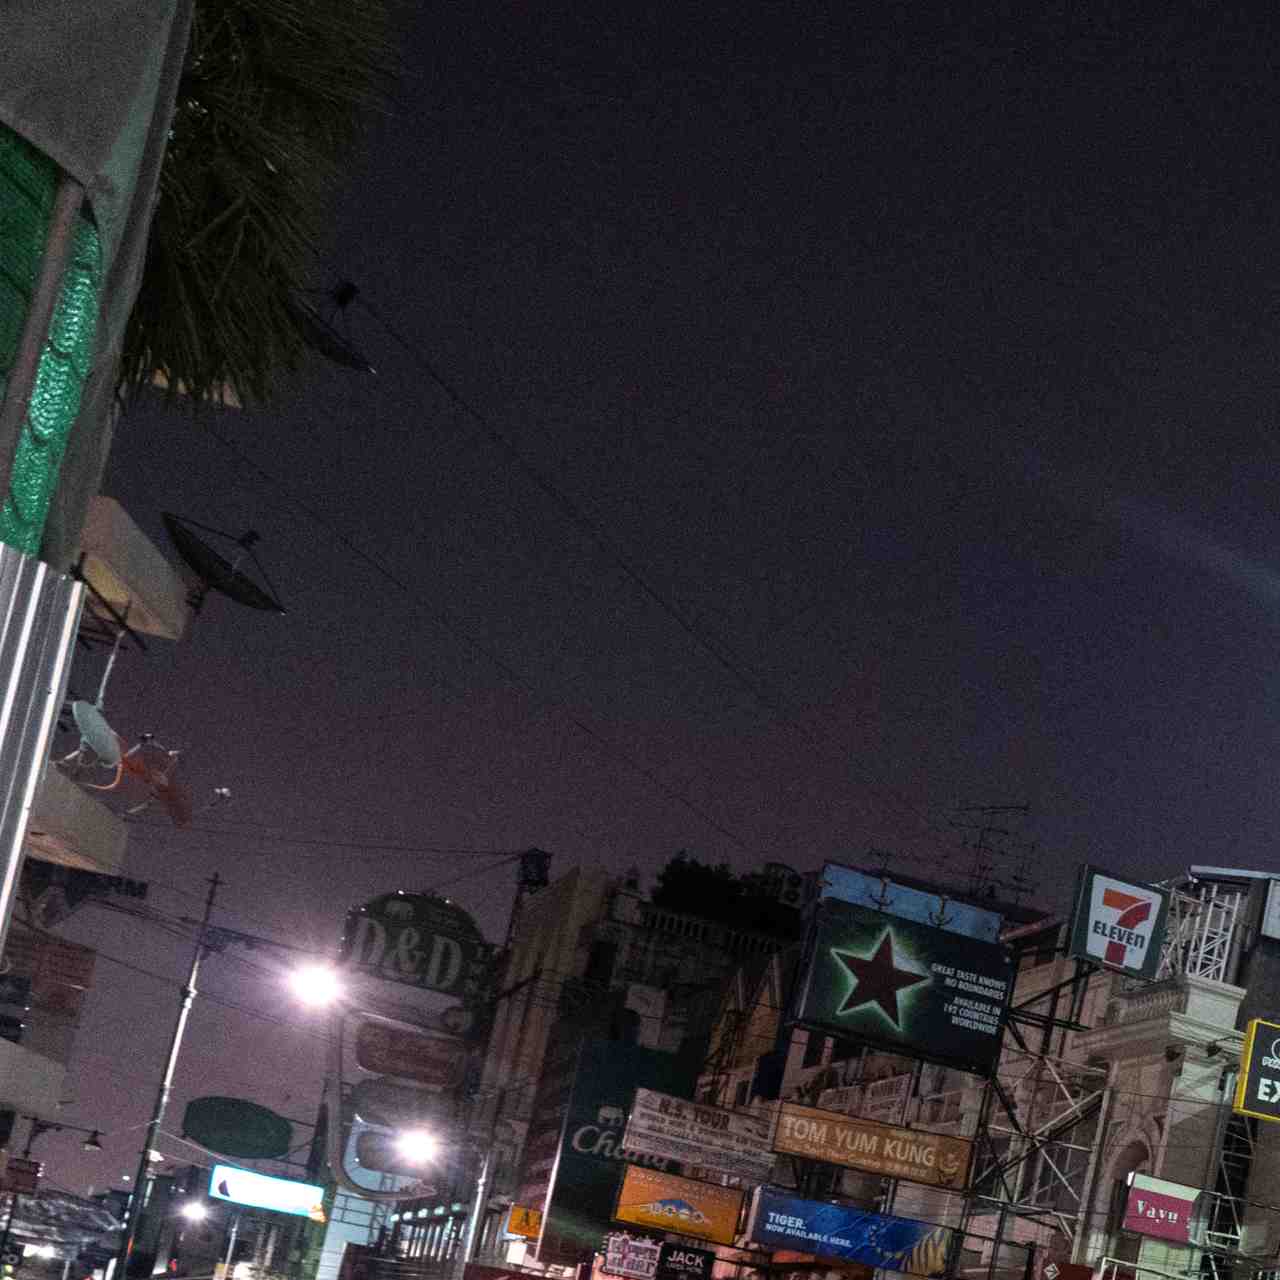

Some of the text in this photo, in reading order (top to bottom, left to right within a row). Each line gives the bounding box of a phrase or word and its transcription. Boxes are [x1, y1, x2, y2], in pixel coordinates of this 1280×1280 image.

[783, 1117, 827, 1144] TOM
[834, 1126, 880, 1154] YUM
[883, 1137, 936, 1167] KUNG
[765, 1223, 784, 1235] NOW
[784, 1227, 828, 1244] AVAILABLE
[667, 1250, 705, 1269] JACK
